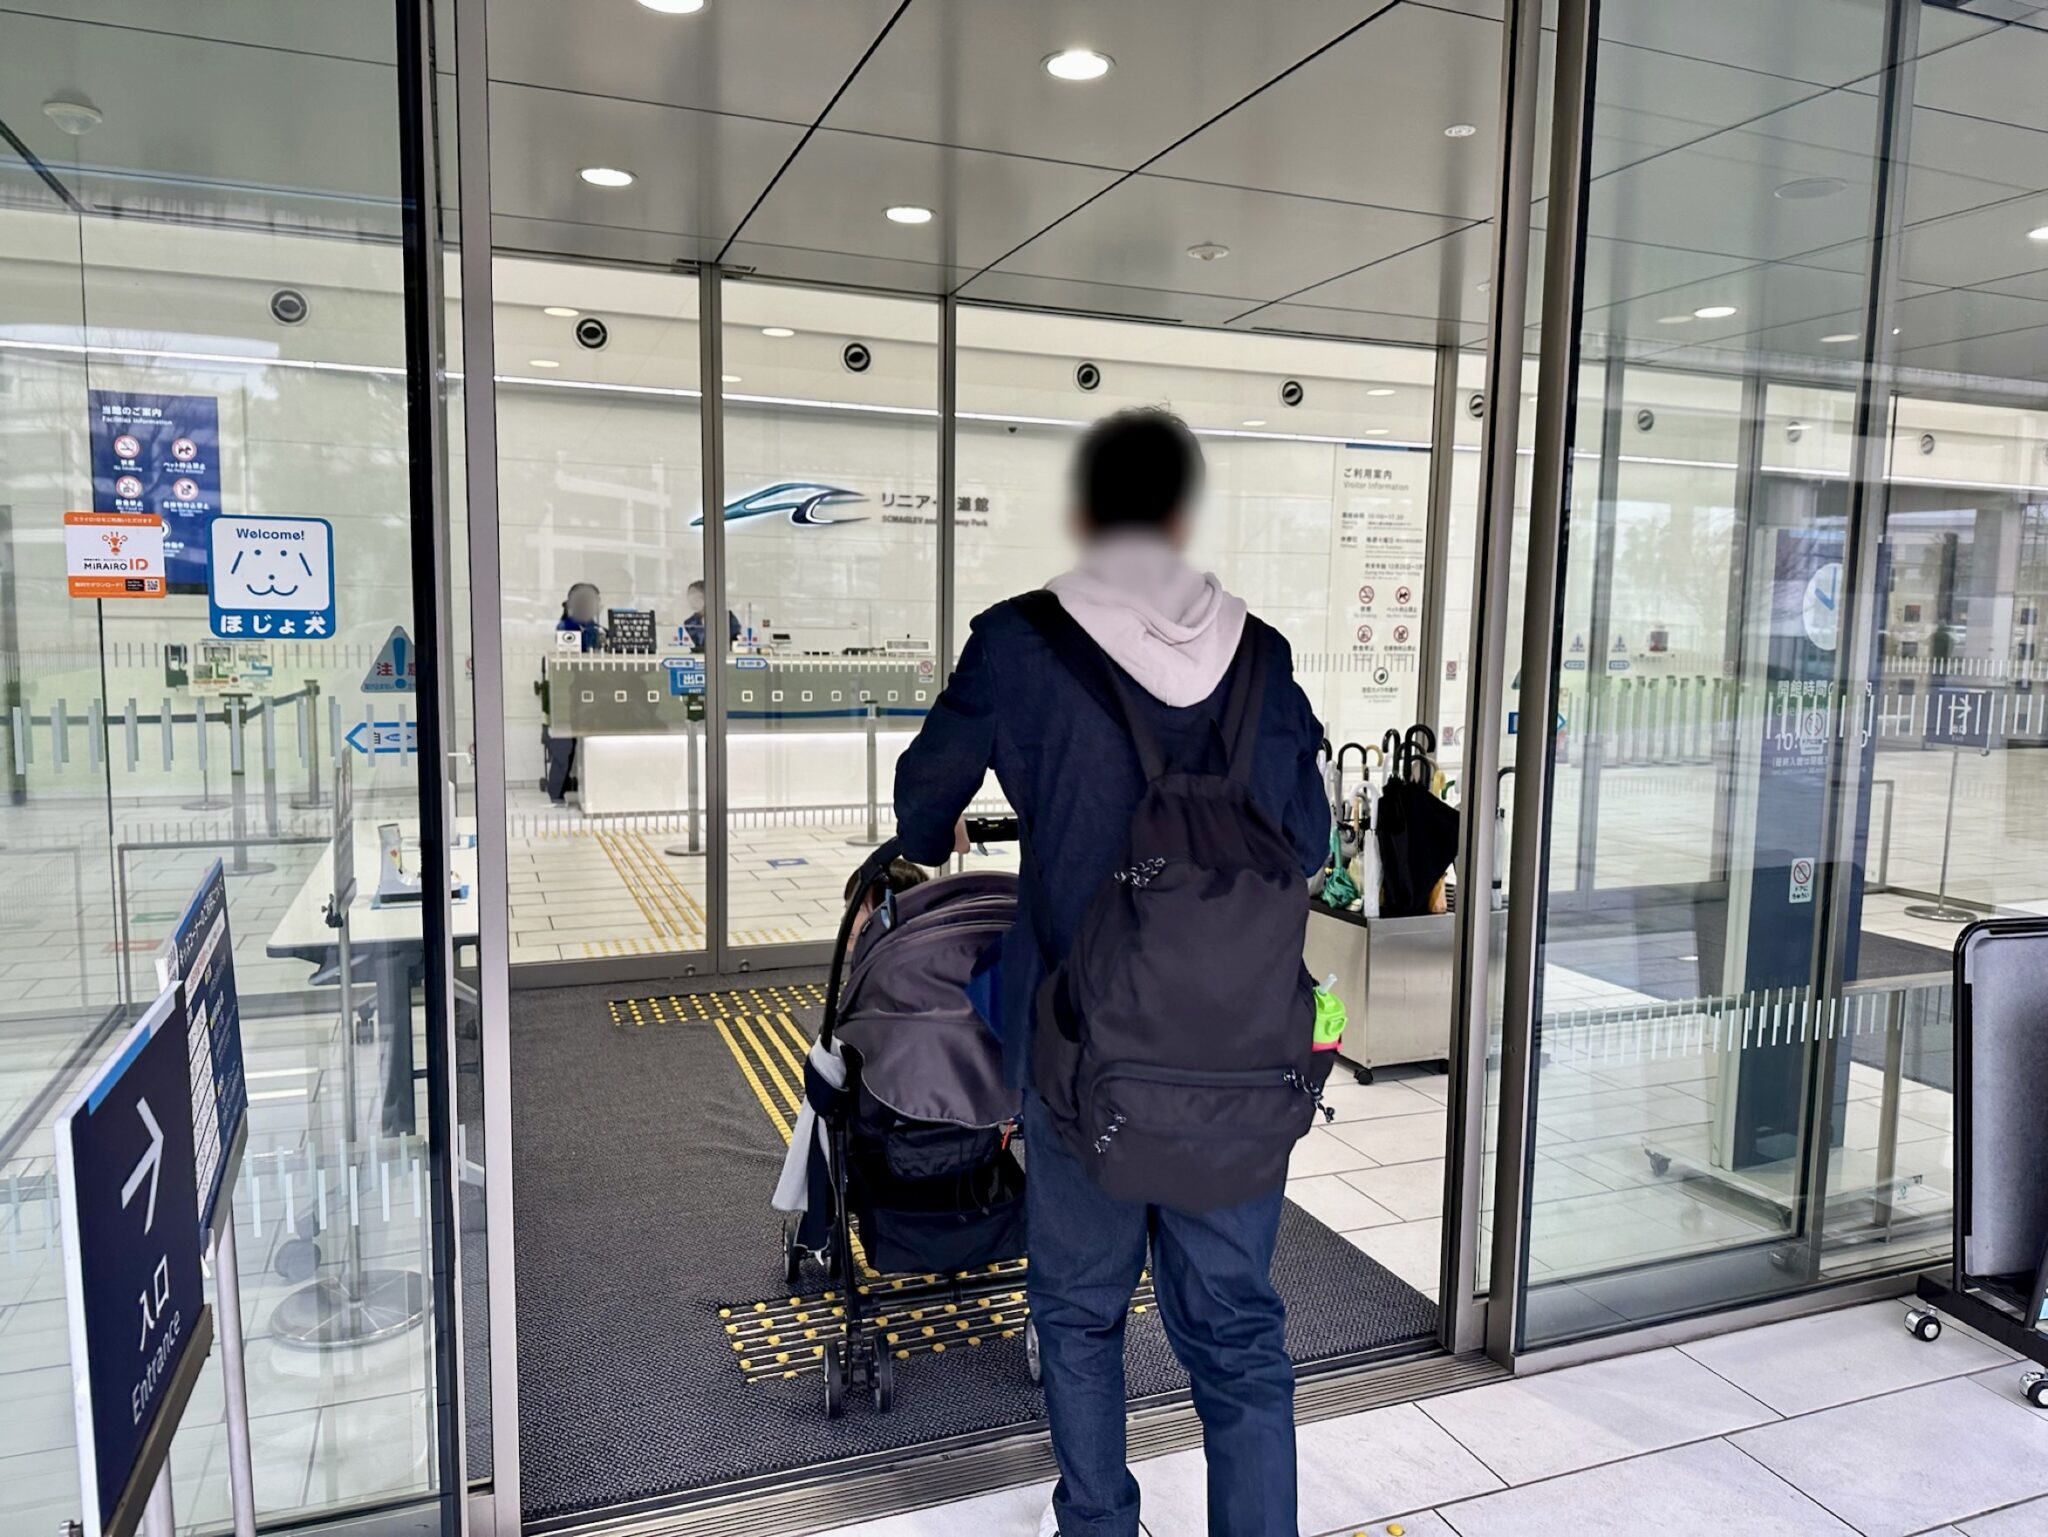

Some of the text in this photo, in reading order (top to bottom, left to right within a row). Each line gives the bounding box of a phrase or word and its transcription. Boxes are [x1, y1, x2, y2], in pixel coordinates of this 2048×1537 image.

[1343, 467, 1393, 480] ご利用案内
[882, 492, 989, 512] リニア・道館
[236, 527, 304, 541] Welcome!
[129, 558, 149, 571] ID
[220, 615, 327, 635] ほじょ犬
[683, 674, 705, 686] 出口
[139, 1253, 170, 1352] 入口
[131, 1310, 181, 1426] Entrance
